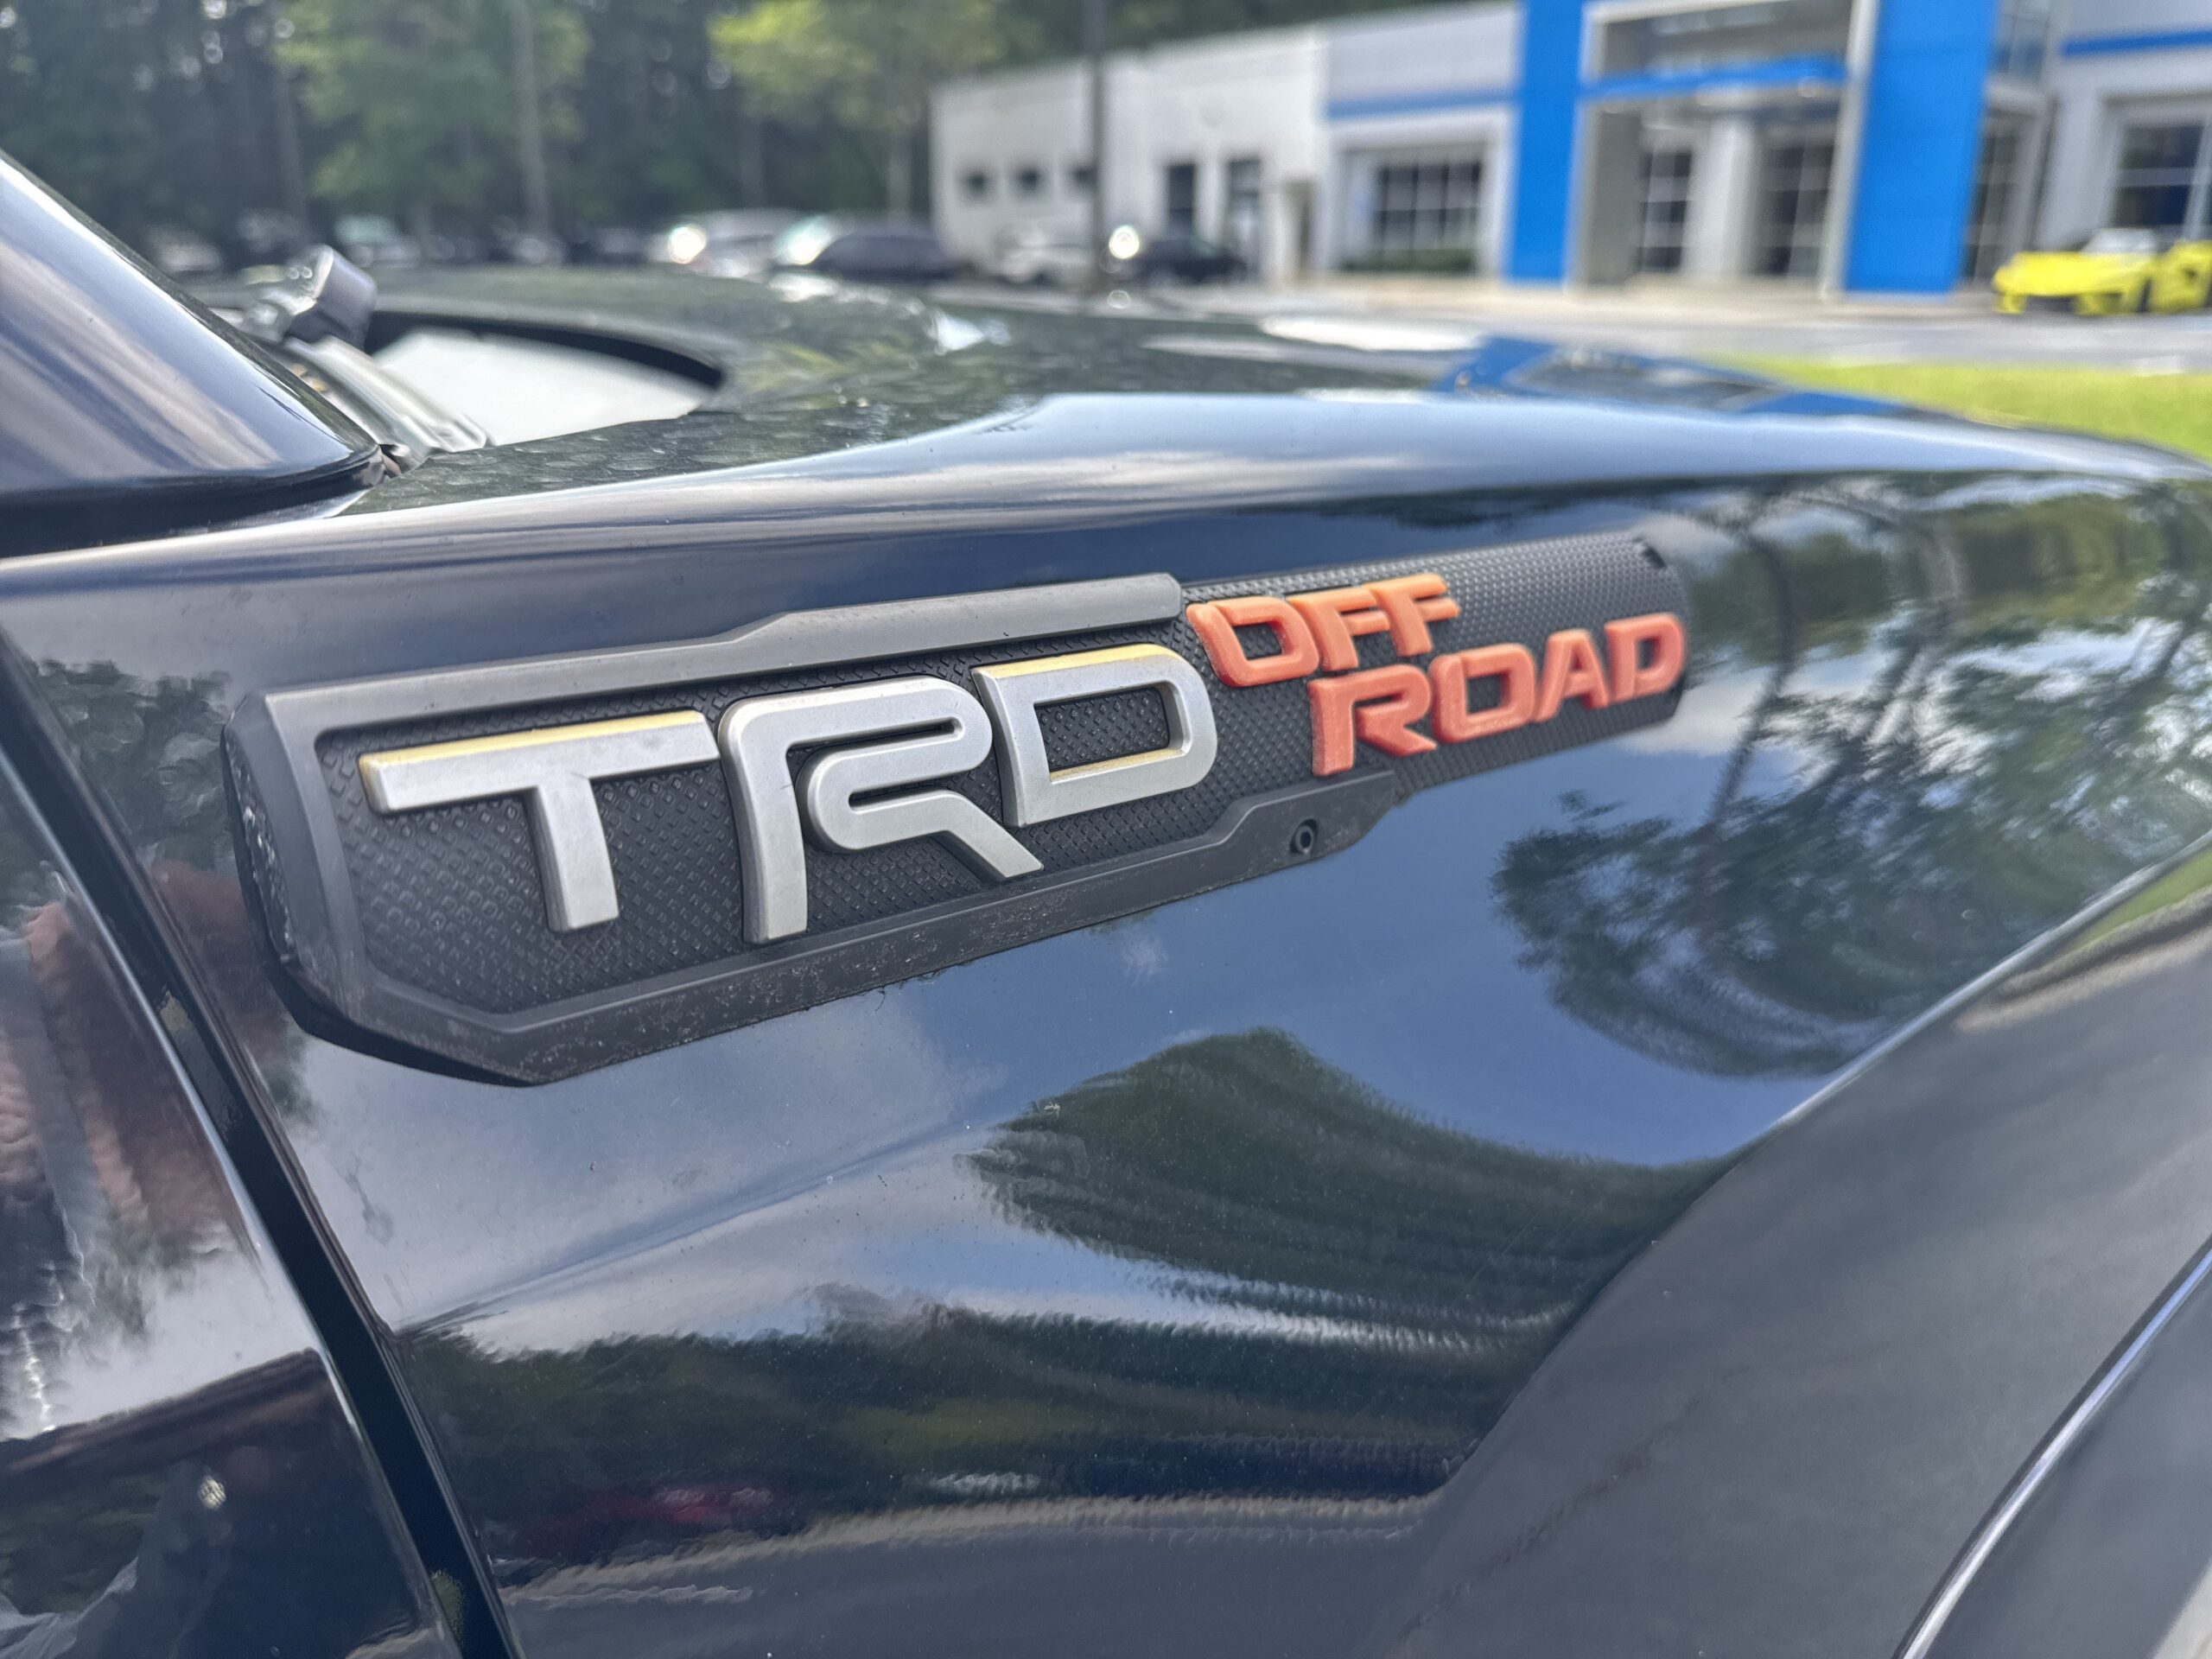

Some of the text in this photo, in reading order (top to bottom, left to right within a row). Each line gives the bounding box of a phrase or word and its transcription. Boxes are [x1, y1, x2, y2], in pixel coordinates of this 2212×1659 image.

[1186, 573, 1460, 688] OFF
[1307, 613, 1686, 776] ROAD
[359, 643, 1217, 944] TRD
